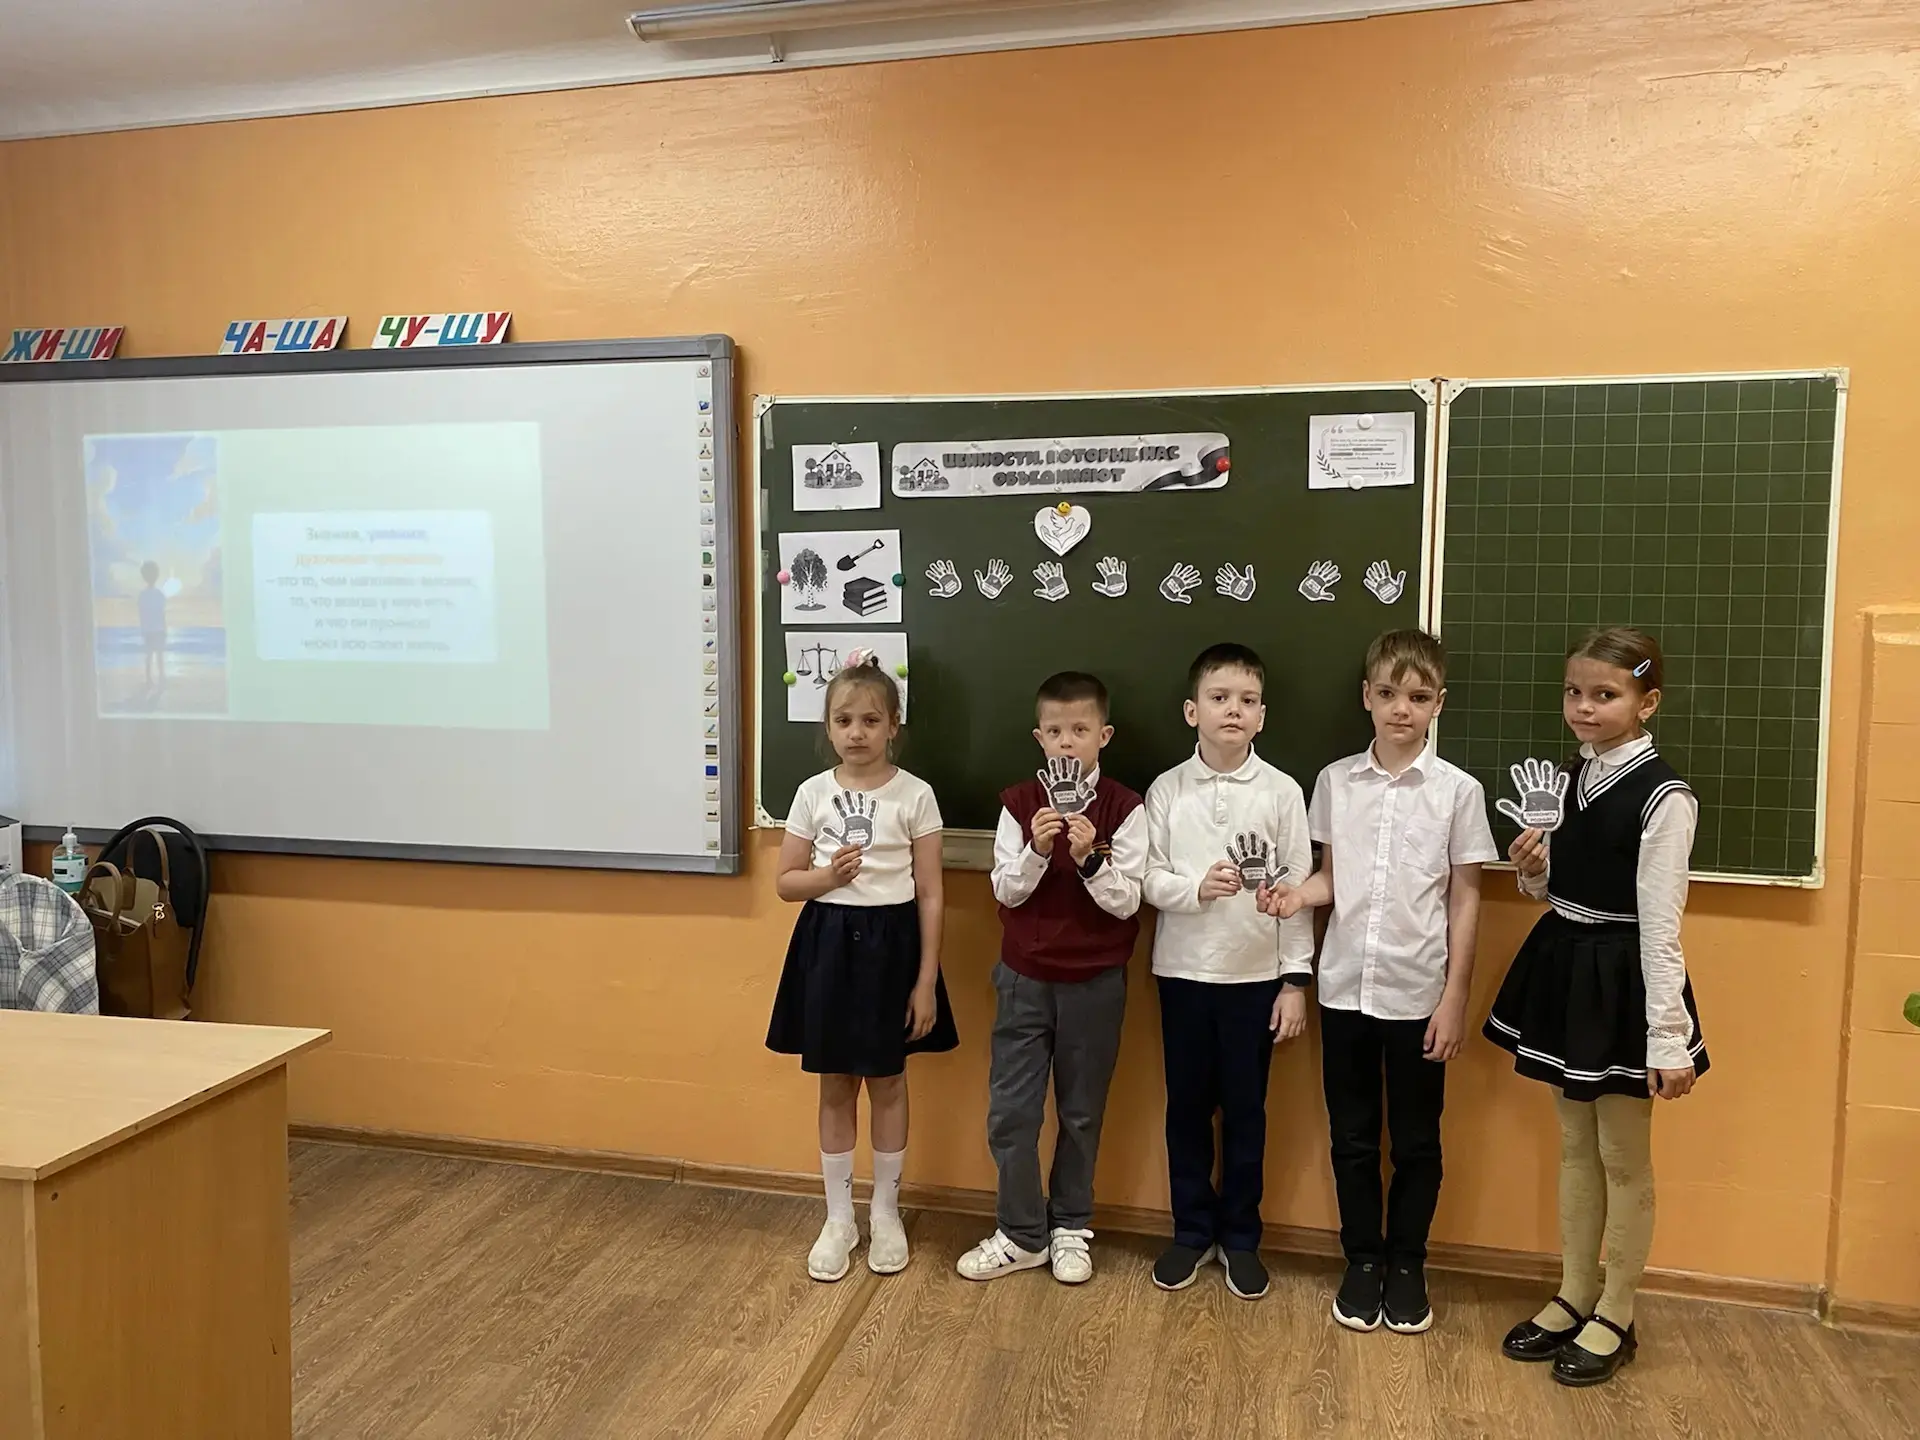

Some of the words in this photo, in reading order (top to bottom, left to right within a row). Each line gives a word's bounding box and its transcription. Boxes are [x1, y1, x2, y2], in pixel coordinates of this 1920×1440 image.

[1, 329, 123, 361] ЖИ-ШИ
[225, 319, 337, 353] ЧА-ЩА
[380, 312, 509, 348] ЧУ-ЩУ
[1139, 445, 1181, 461] НАС
